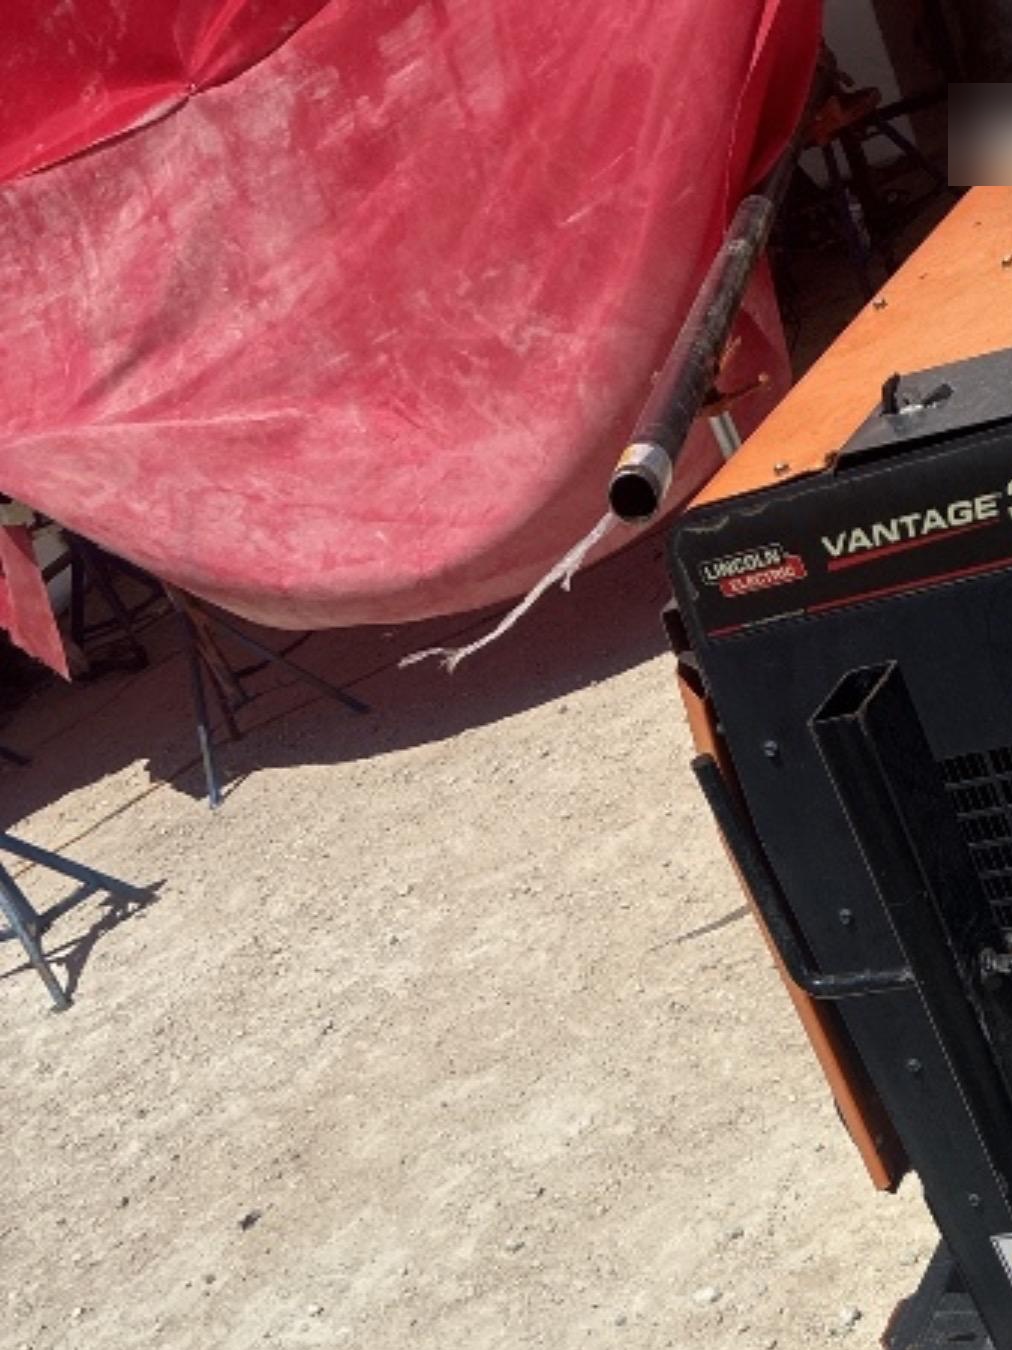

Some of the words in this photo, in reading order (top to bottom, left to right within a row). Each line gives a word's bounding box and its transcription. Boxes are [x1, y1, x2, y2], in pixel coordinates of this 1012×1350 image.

[821, 493, 1001, 557] VANTAGE
[704, 549, 781, 579] LINCOLN
[729, 566, 796, 589] ELECTRIC
